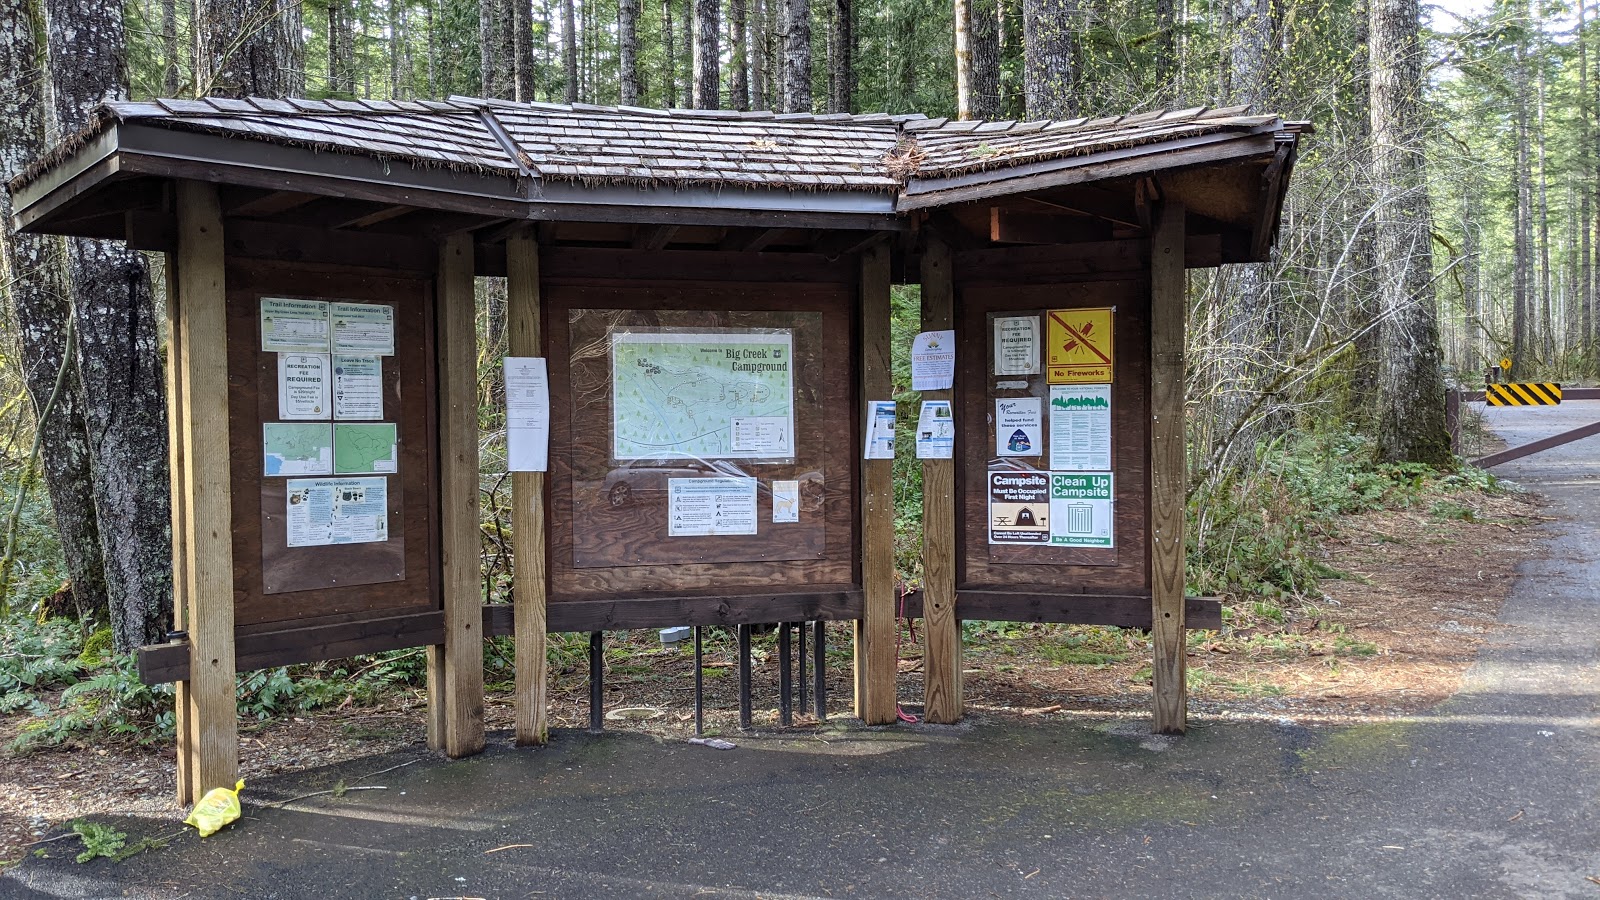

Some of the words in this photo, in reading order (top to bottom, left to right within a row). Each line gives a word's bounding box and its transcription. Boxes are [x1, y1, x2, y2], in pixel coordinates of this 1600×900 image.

[923, 332, 944, 342] SUNNY
[726, 348, 740, 360] Big
[743, 349, 768, 358] Creek
[732, 362, 788, 373] Campground
[1000, 402, 1016, 414] Your
[994, 476, 1046, 486] Campsite
[1053, 476, 1086, 486] Clean
[1092, 476, 1108, 488] Up
[1053, 487, 1108, 498] Campsite
